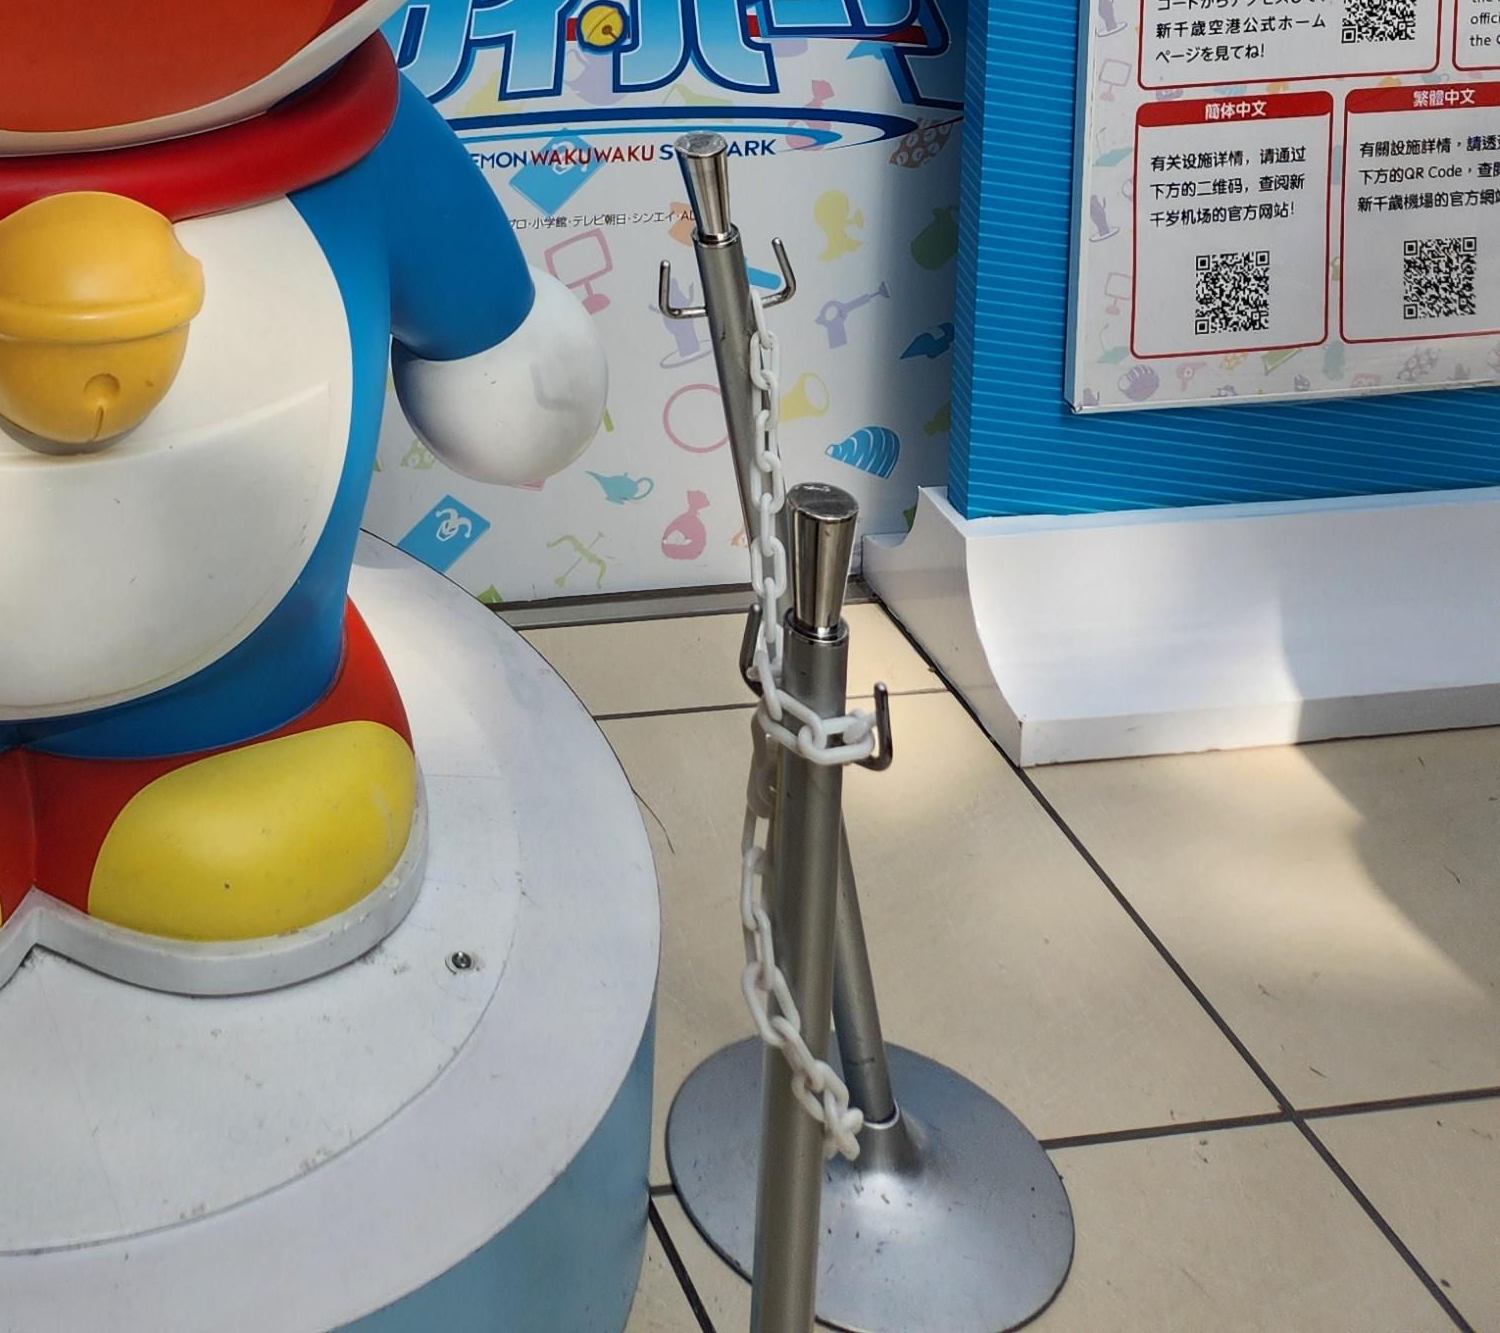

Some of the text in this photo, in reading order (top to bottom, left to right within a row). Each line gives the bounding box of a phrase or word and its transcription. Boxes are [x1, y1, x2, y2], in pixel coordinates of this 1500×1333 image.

[1156, 14, 1327, 40] 新千歳空港公式ホーム
[1469, 34, 1492, 47] the
[1412, 88, 1477, 108] 繁體中文
[530, 144, 655, 167] WAKUWAKU
